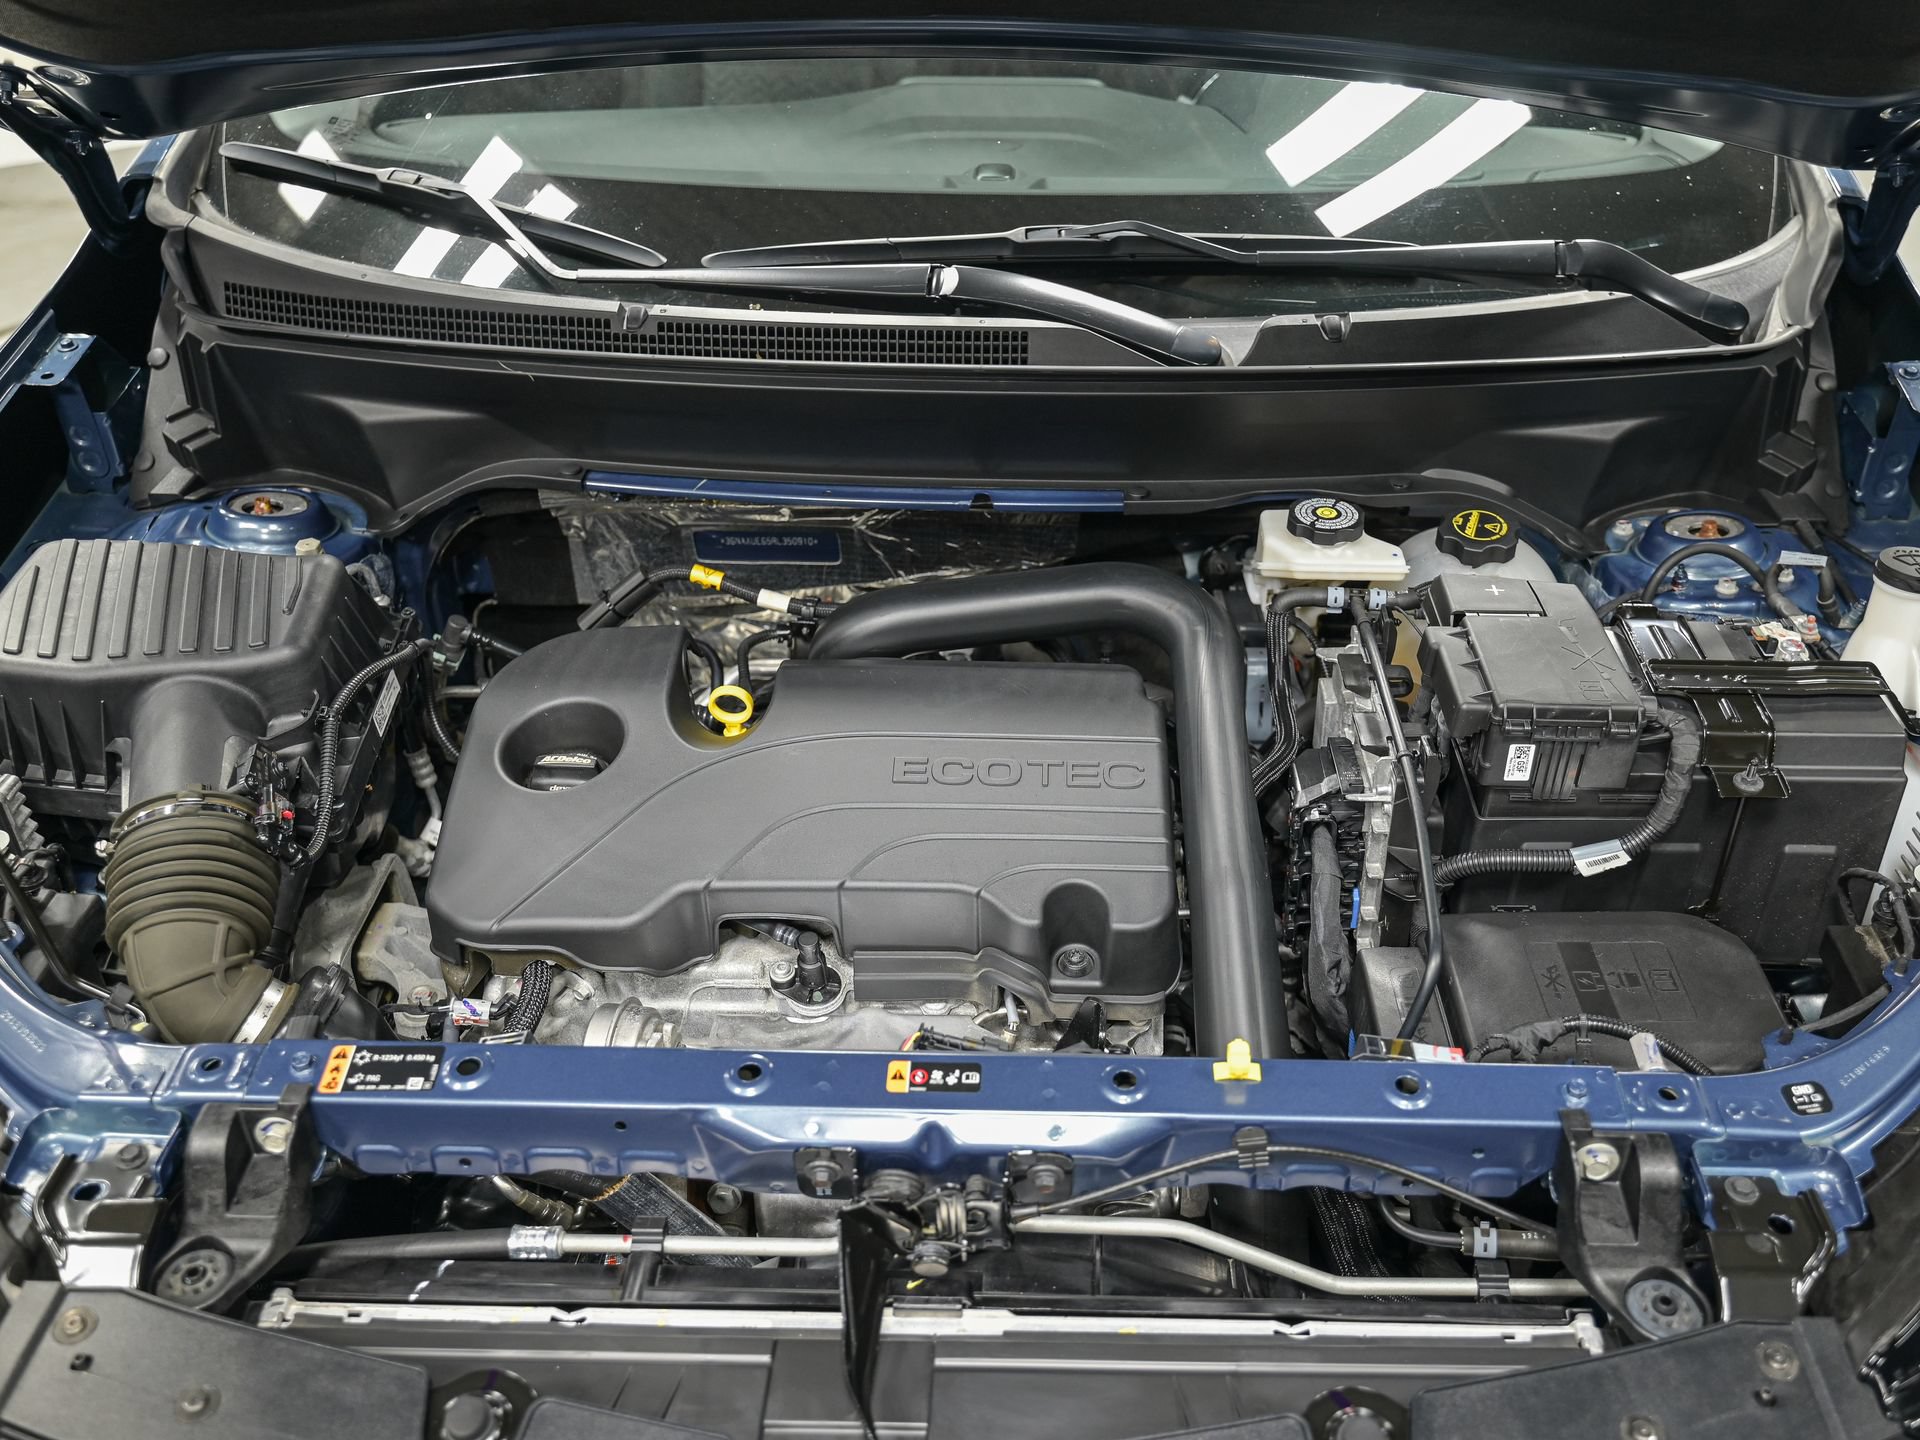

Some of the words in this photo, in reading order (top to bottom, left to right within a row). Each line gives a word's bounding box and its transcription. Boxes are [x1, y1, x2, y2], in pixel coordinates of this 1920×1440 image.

[541, 755, 592, 764] ACDelco
[892, 756, 1146, 789] ECOTEC
[372, 1053, 405, 1063] R-1234yf
[365, 1074, 381, 1083] PAG
[1791, 1084, 1815, 1096] GND
